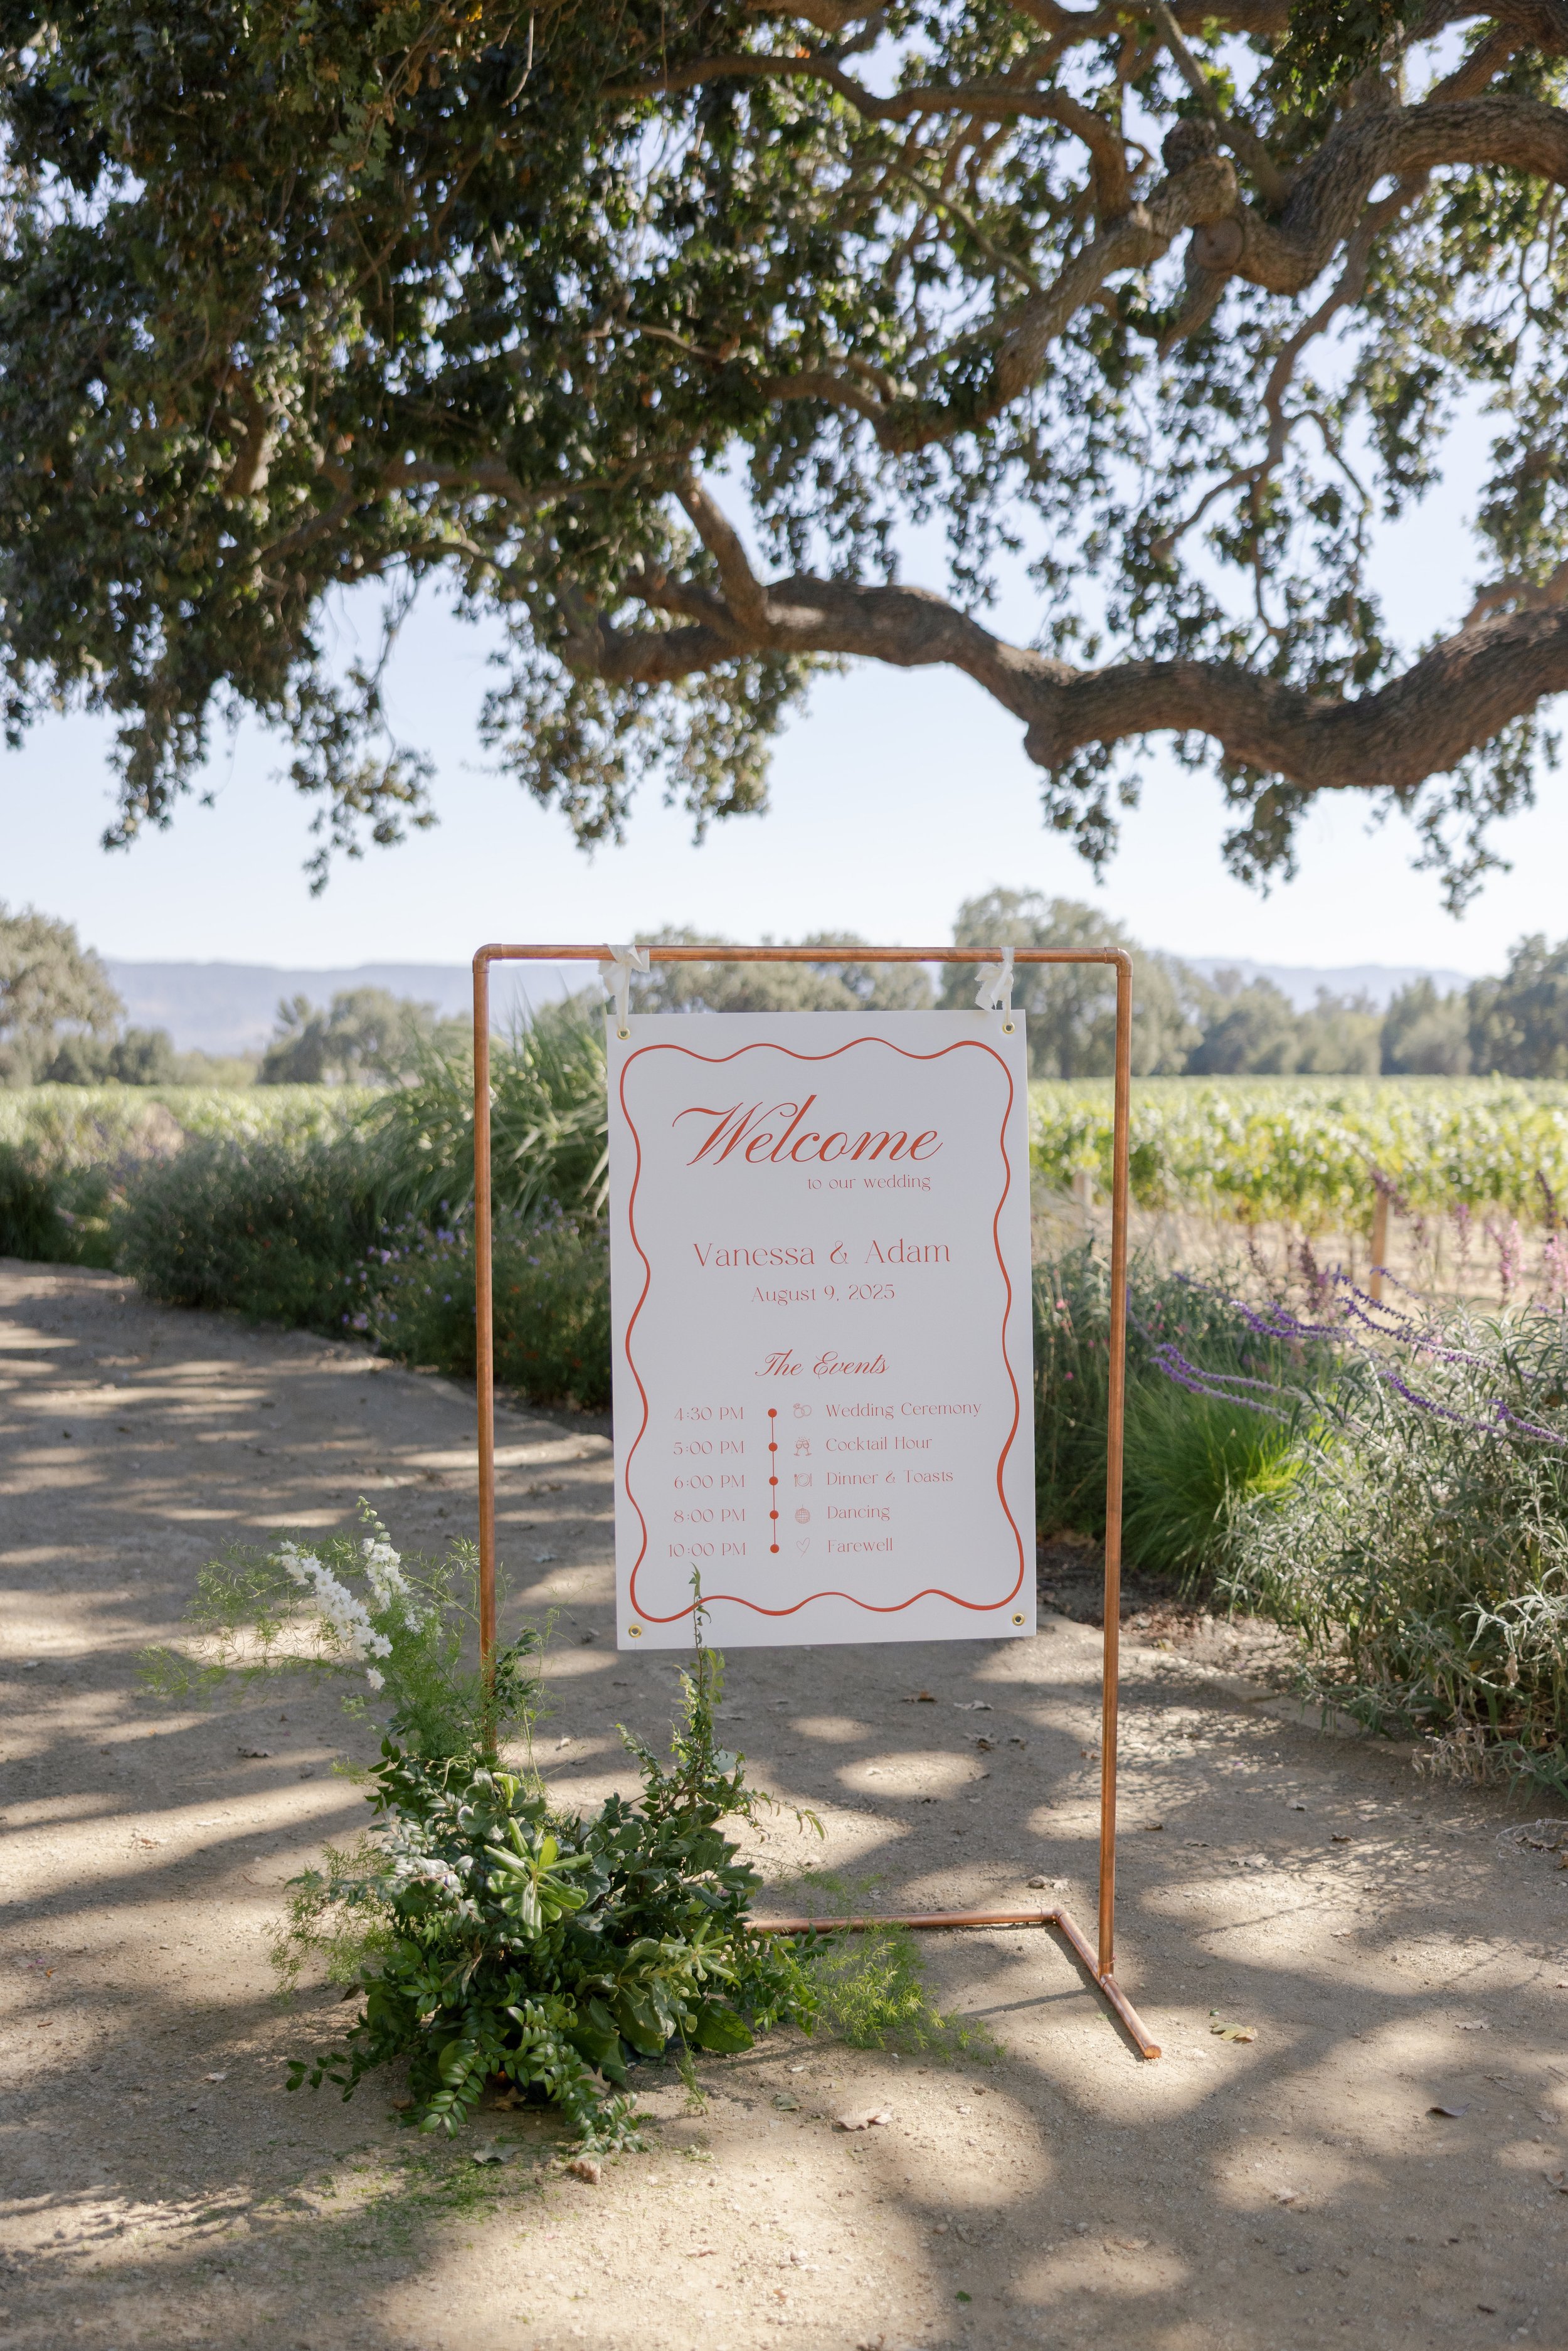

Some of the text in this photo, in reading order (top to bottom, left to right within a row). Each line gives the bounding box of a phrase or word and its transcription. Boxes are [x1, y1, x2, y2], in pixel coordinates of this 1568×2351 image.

[672, 1093, 944, 1167] Welcome
[807, 1174, 932, 1191] to our wedding
[692, 1238, 950, 1268] Vanessa & Adam
[751, 1283, 895, 1305] August 9, 2025
[754, 1349, 889, 1379] The Events
[674, 1402, 982, 1421] 4:30 PM Wedding Ceremony
[673, 1436, 933, 1455] 5:00 PM Cocktail Hour
[674, 1469, 953, 1490] 6:00 PM Dinner & Toasts
[673, 1505, 890, 1524] 8:00 PM Dancing
[669, 1537, 893, 1558] 10:00 PM Farewell
